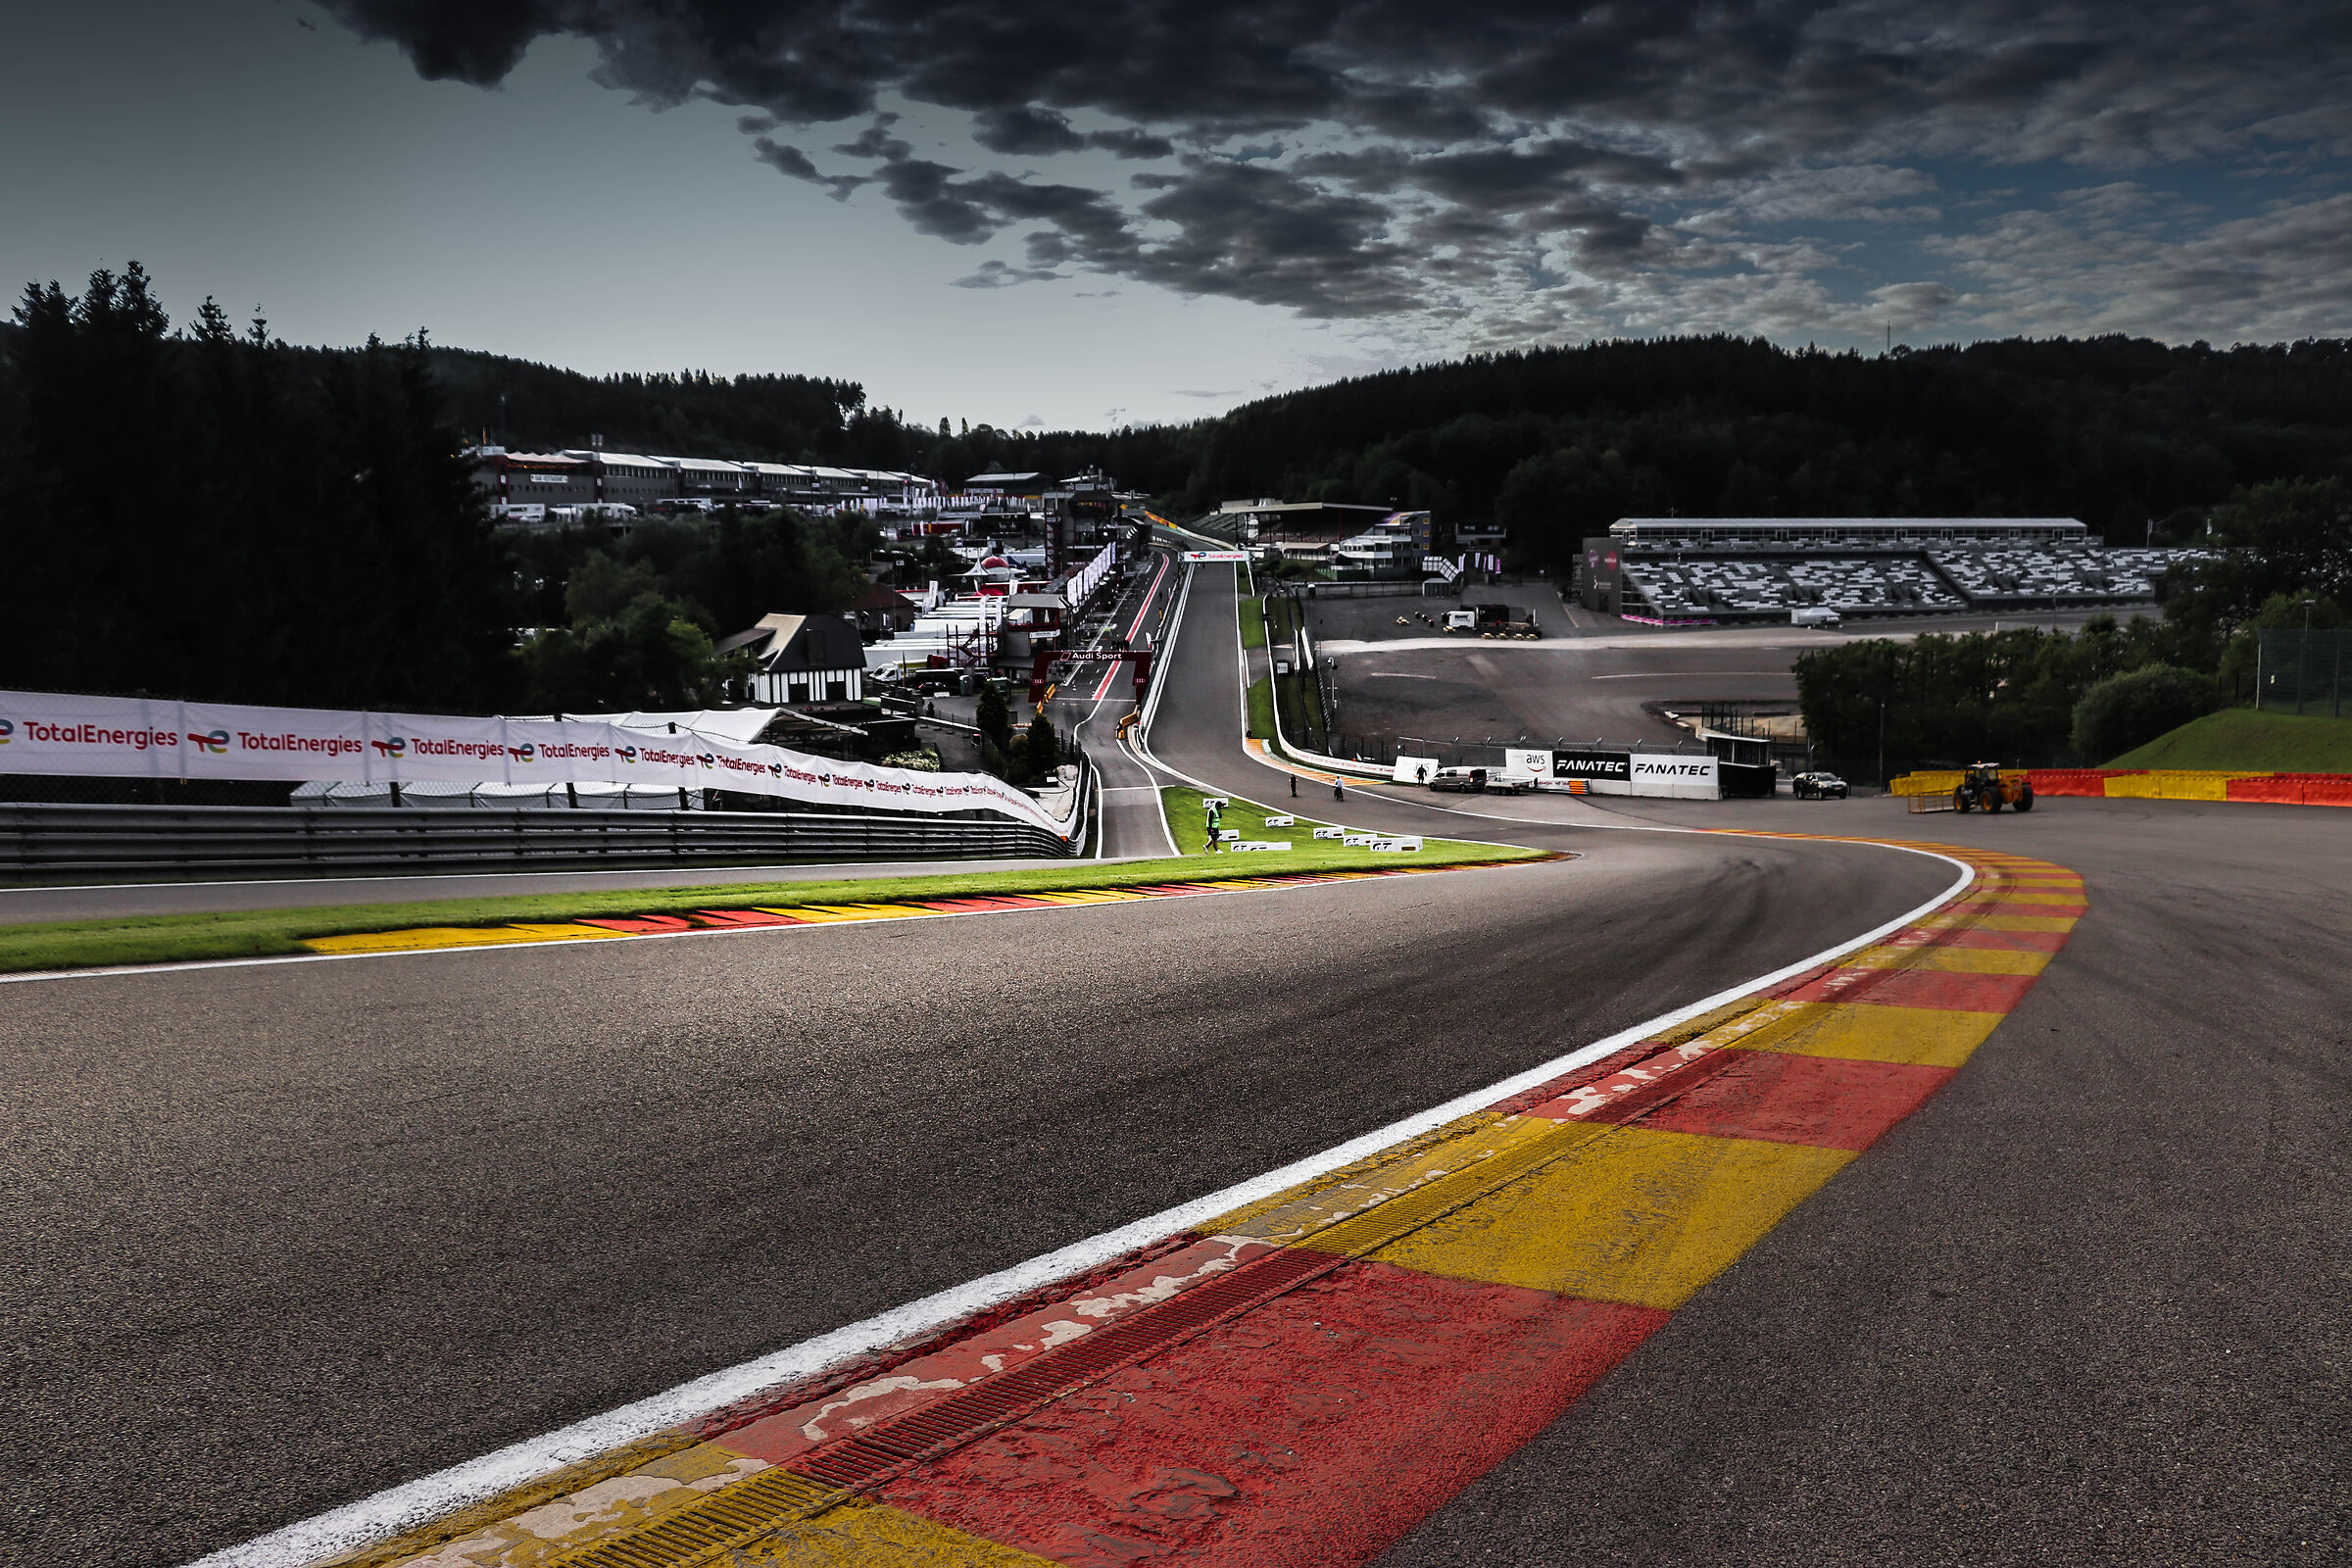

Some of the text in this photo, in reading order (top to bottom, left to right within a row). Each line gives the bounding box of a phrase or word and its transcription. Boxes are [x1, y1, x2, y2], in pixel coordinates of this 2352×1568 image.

[1096, 652, 1122, 661] Sport
[23, 721, 178, 751] TotalEnergies
[237, 731, 363, 758] TotalEnergies
[411, 738, 505, 760] TotalEnergies
[538, 743, 610, 761] TotalEnergies
[639, 747, 695, 768] TotalEnergies
[715, 755, 766, 776] TotalEnergies
[1526, 754, 1545, 764] aws
[1556, 760, 1627, 772] FANATEC
[1635, 763, 1711, 776] FANATEC
